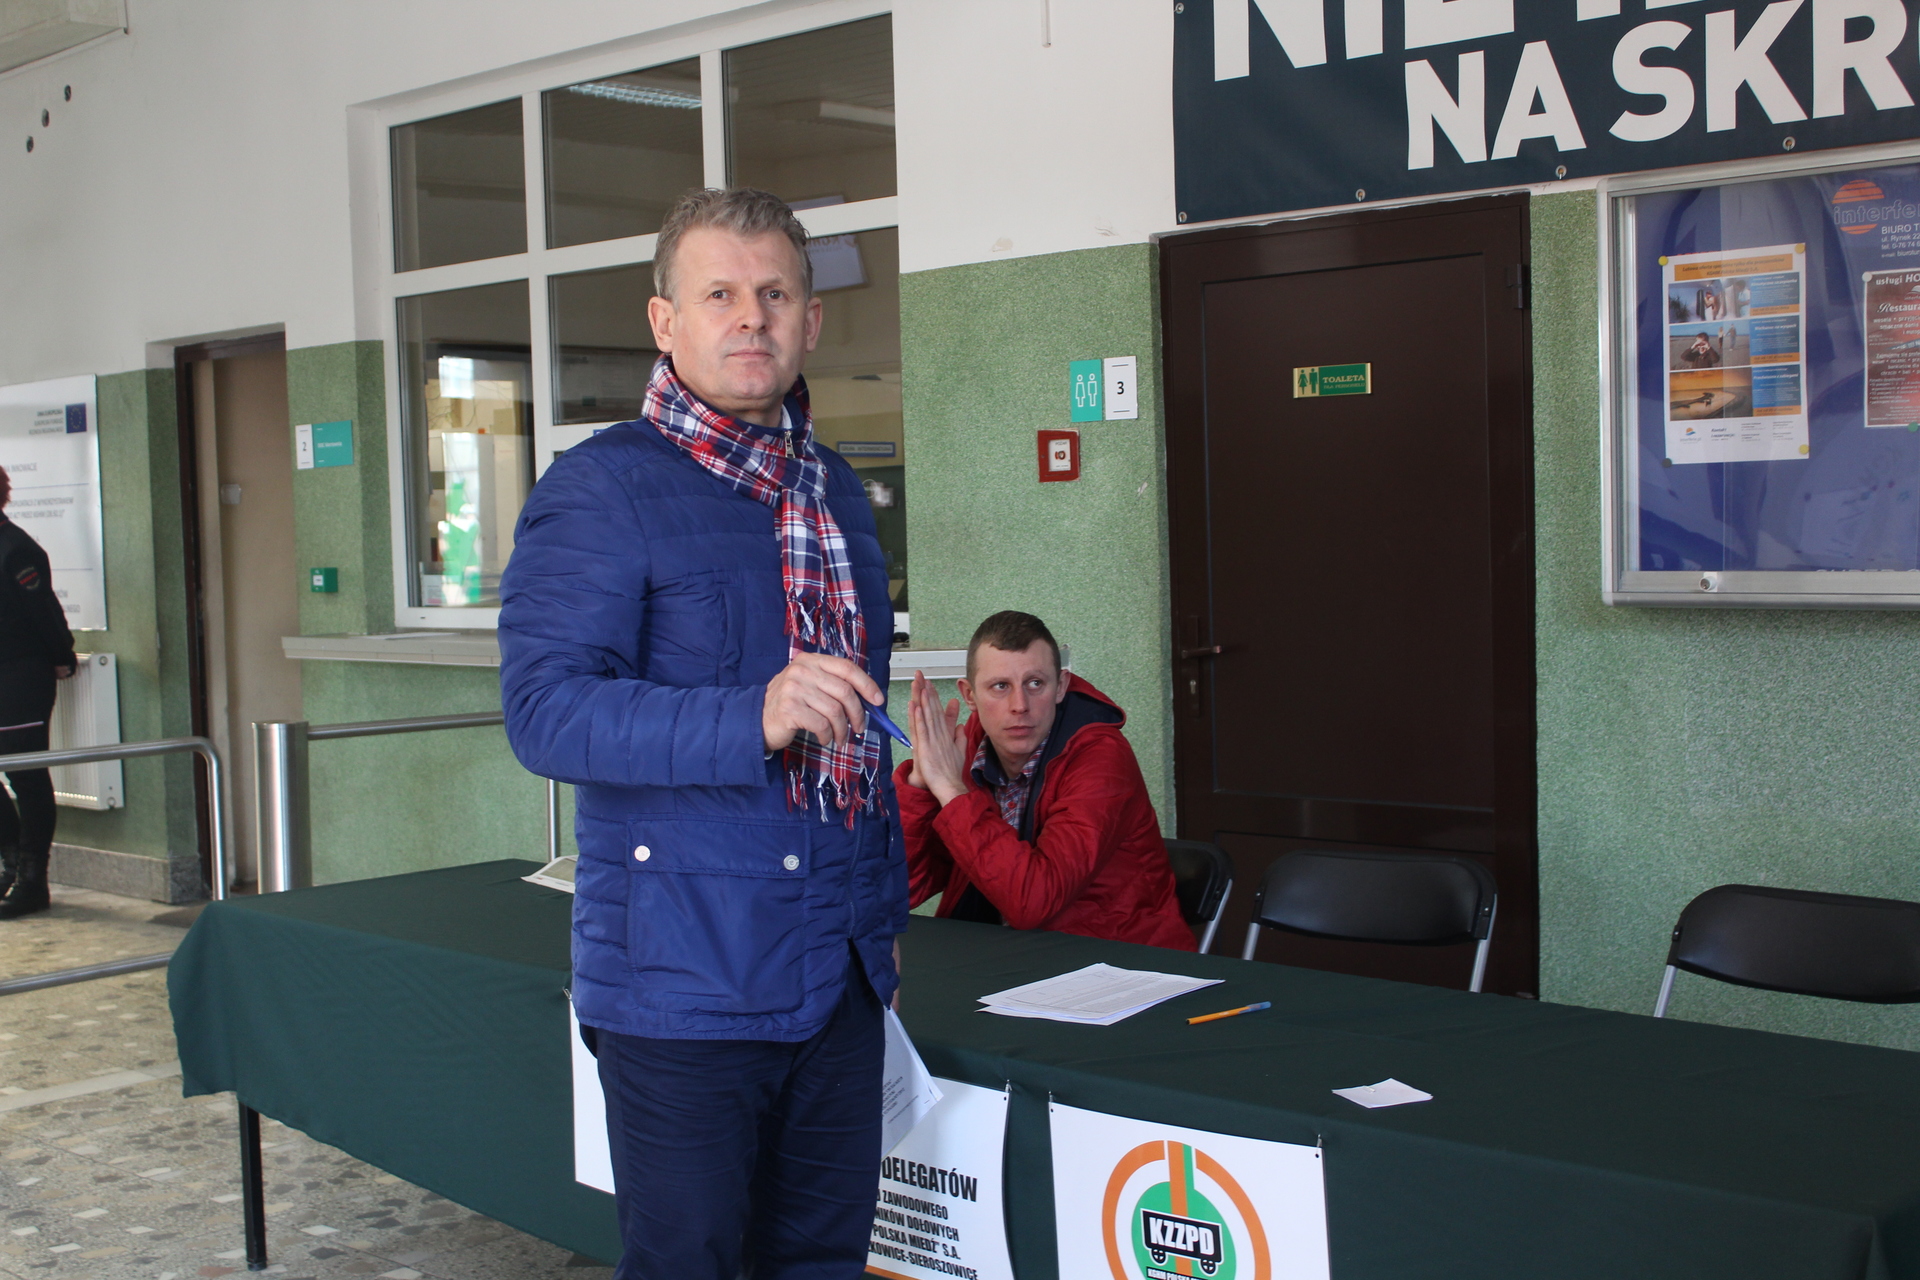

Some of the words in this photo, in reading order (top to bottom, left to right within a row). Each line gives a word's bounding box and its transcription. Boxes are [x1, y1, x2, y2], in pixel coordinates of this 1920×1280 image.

[1405, 40, 1587, 171] NA
[1608, 0, 1920, 142] SKR
[1834, 199, 1920, 225] interfe
[1881, 223, 1912, 235] BIURO
[1876, 274, 1903, 286] usługi
[1116, 381, 1125, 395] 3
[1322, 374, 1365, 384] TOALETA
[302, 441, 307, 452] 2
[881, 1156, 978, 1203] DELEGATÓW
[882, 1189, 949, 1221] ZAWODOWEGO
[907, 1215, 960, 1242] DOŁOWYCH
[1148, 1216, 1215, 1256] KZZPD
[942, 1243, 962, 1261] S.A.
